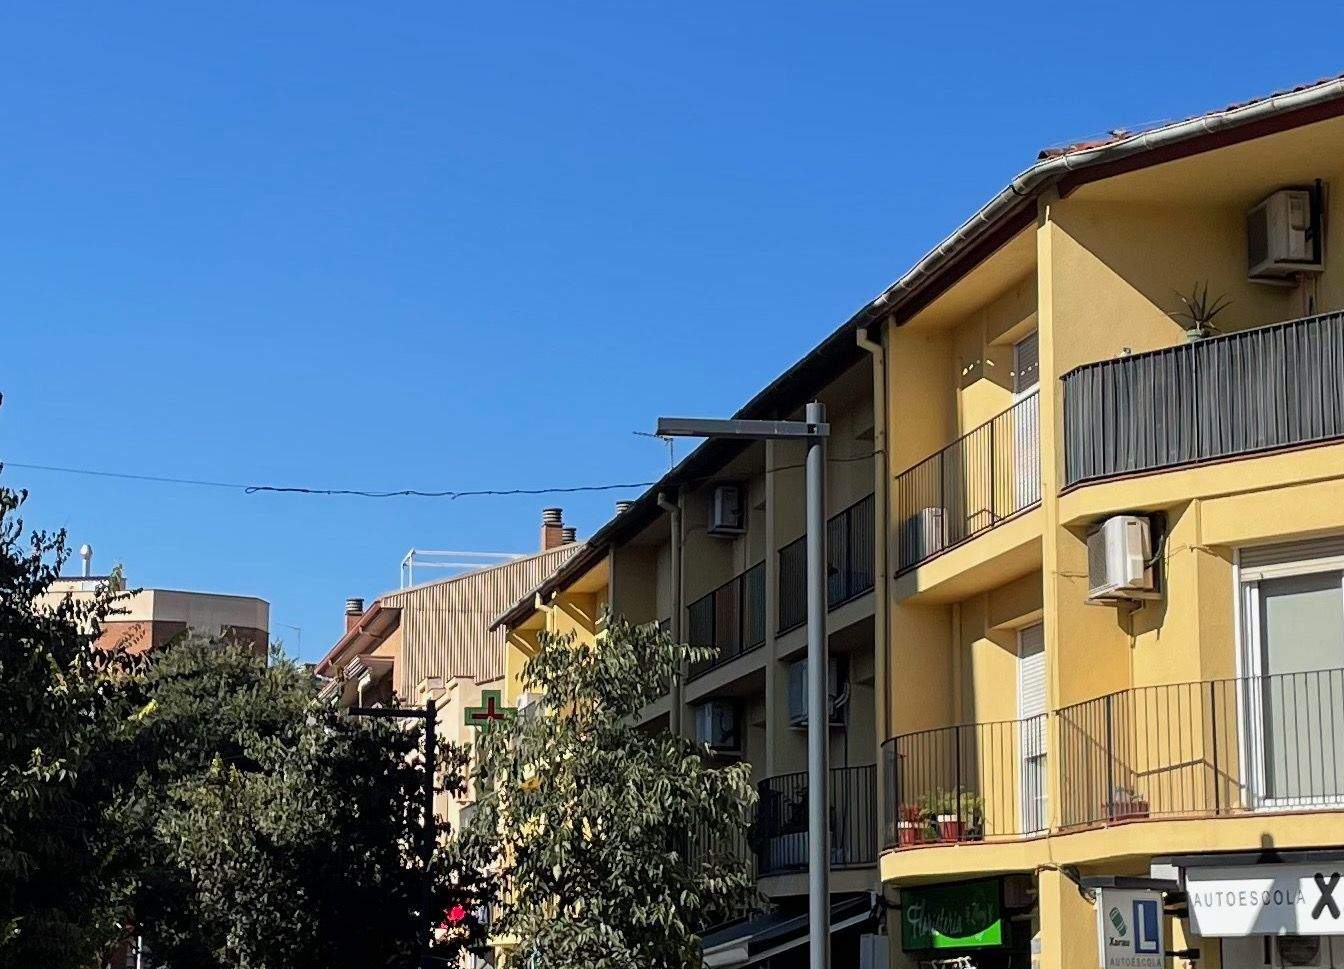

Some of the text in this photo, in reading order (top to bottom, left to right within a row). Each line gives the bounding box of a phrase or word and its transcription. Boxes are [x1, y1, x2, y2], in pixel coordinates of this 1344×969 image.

[1193, 888, 1306, 908] AUTOESCOLA
[1138, 903, 1157, 950] L
[1110, 957, 1162, 968] AUTOESCOLA
